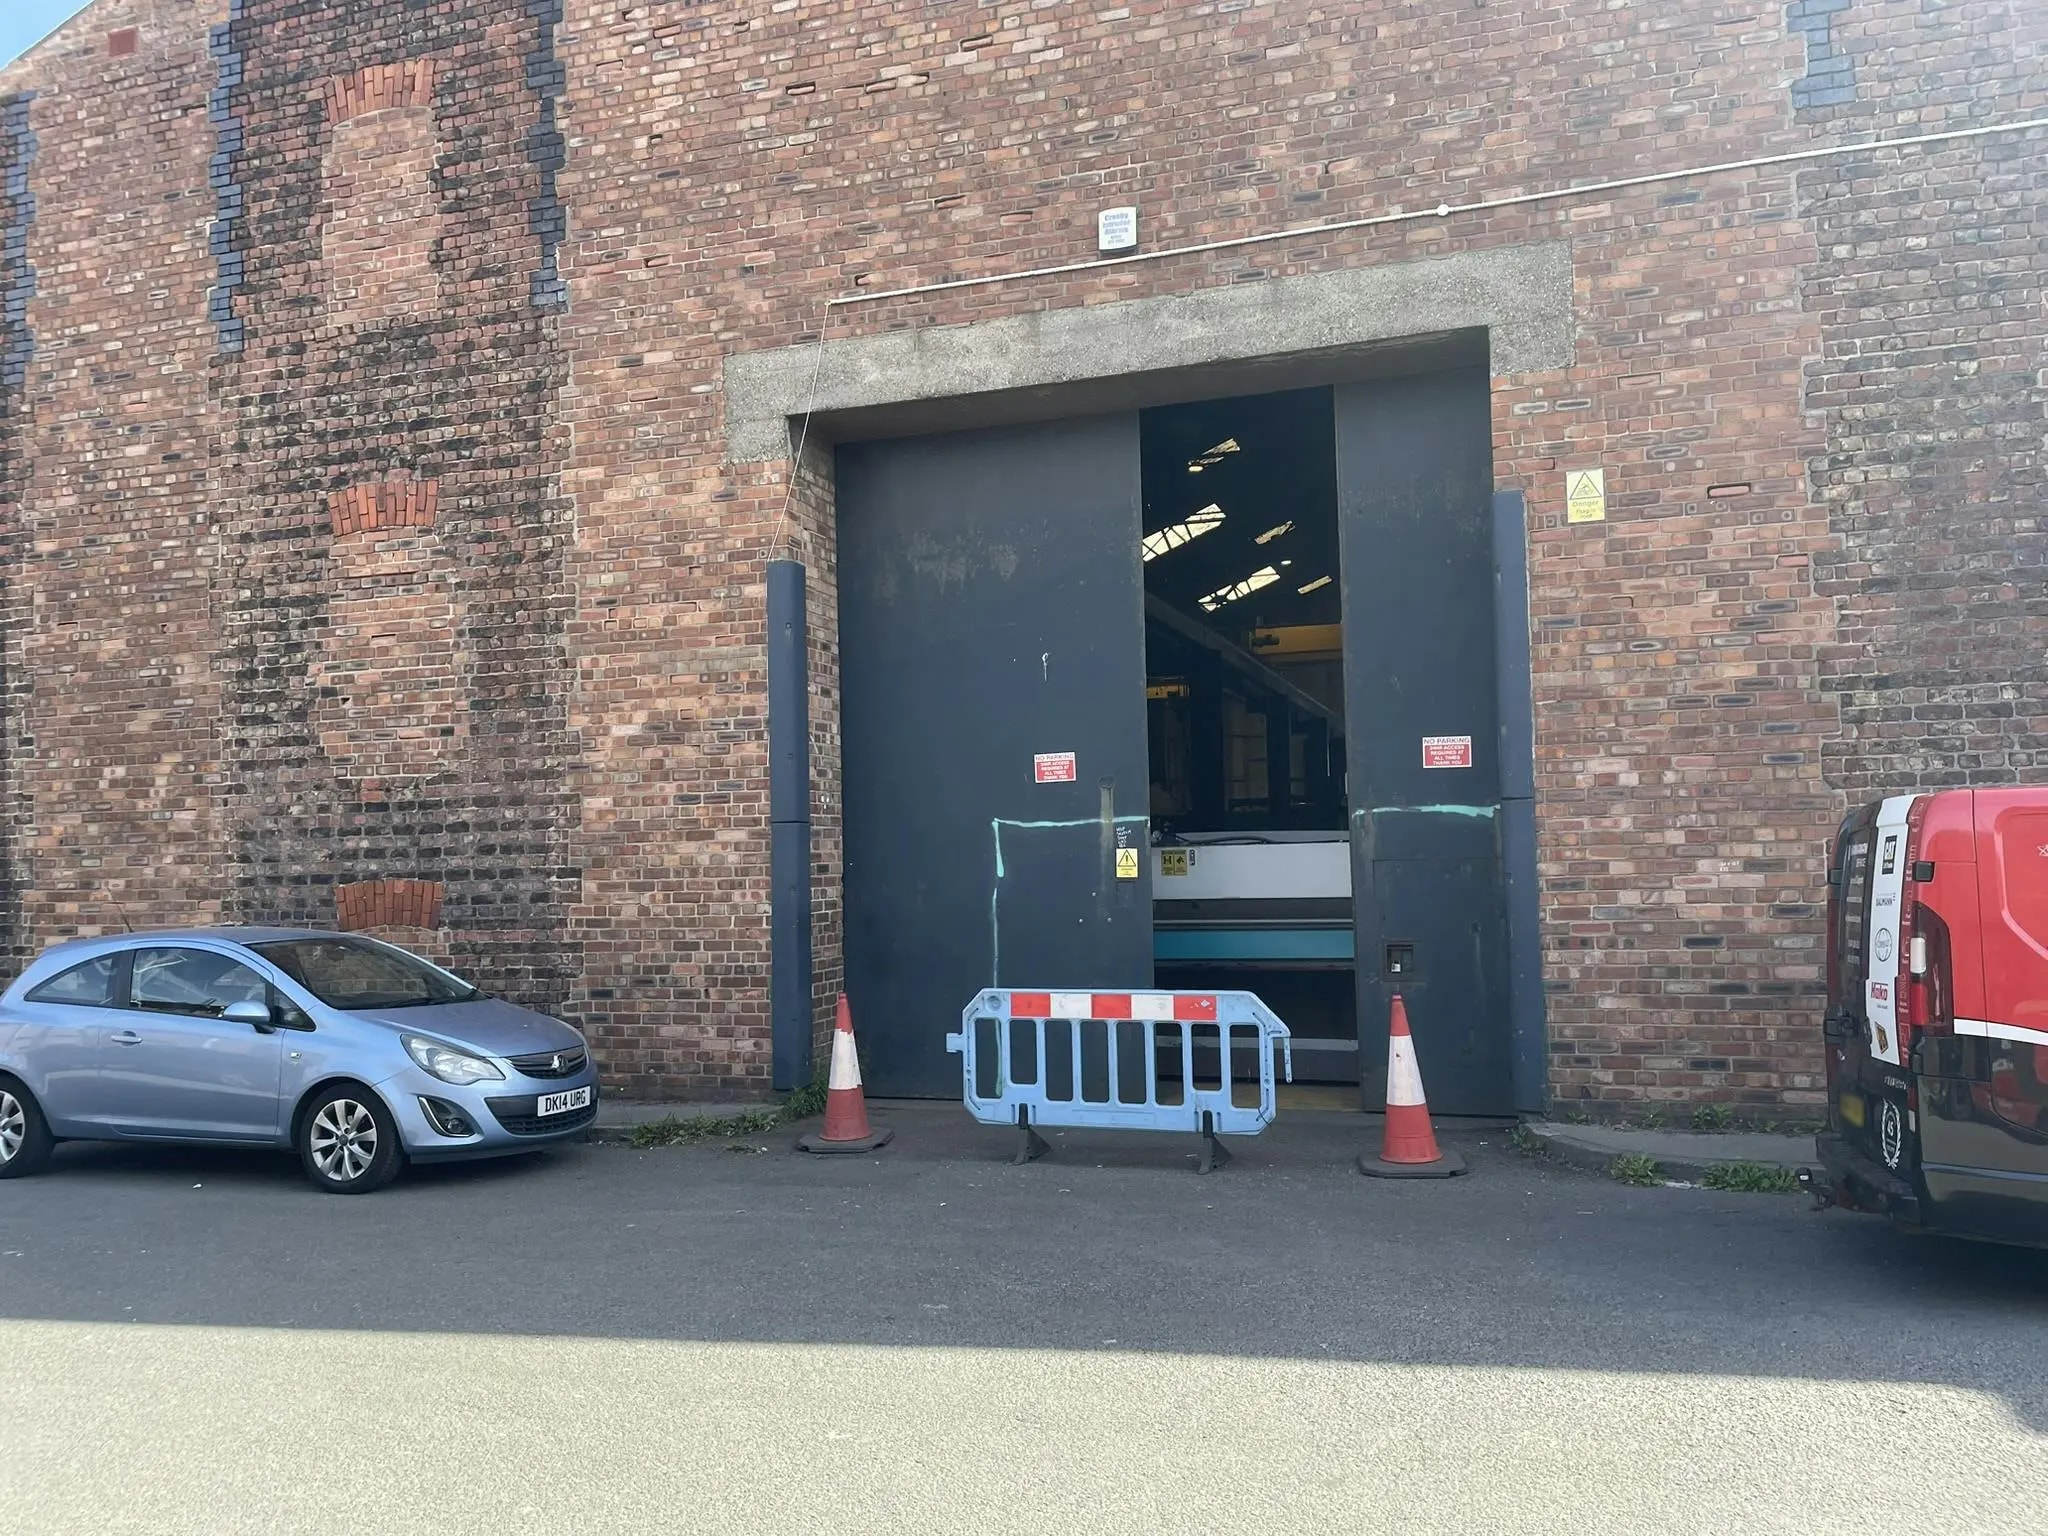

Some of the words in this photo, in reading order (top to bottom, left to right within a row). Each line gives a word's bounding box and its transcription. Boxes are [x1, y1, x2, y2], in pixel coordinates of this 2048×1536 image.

[1884, 841, 1896, 860] CAT
[1871, 982, 1888, 1001] Hako
[544, 1092, 569, 1113] DK14
[570, 1090, 586, 1107] URG
